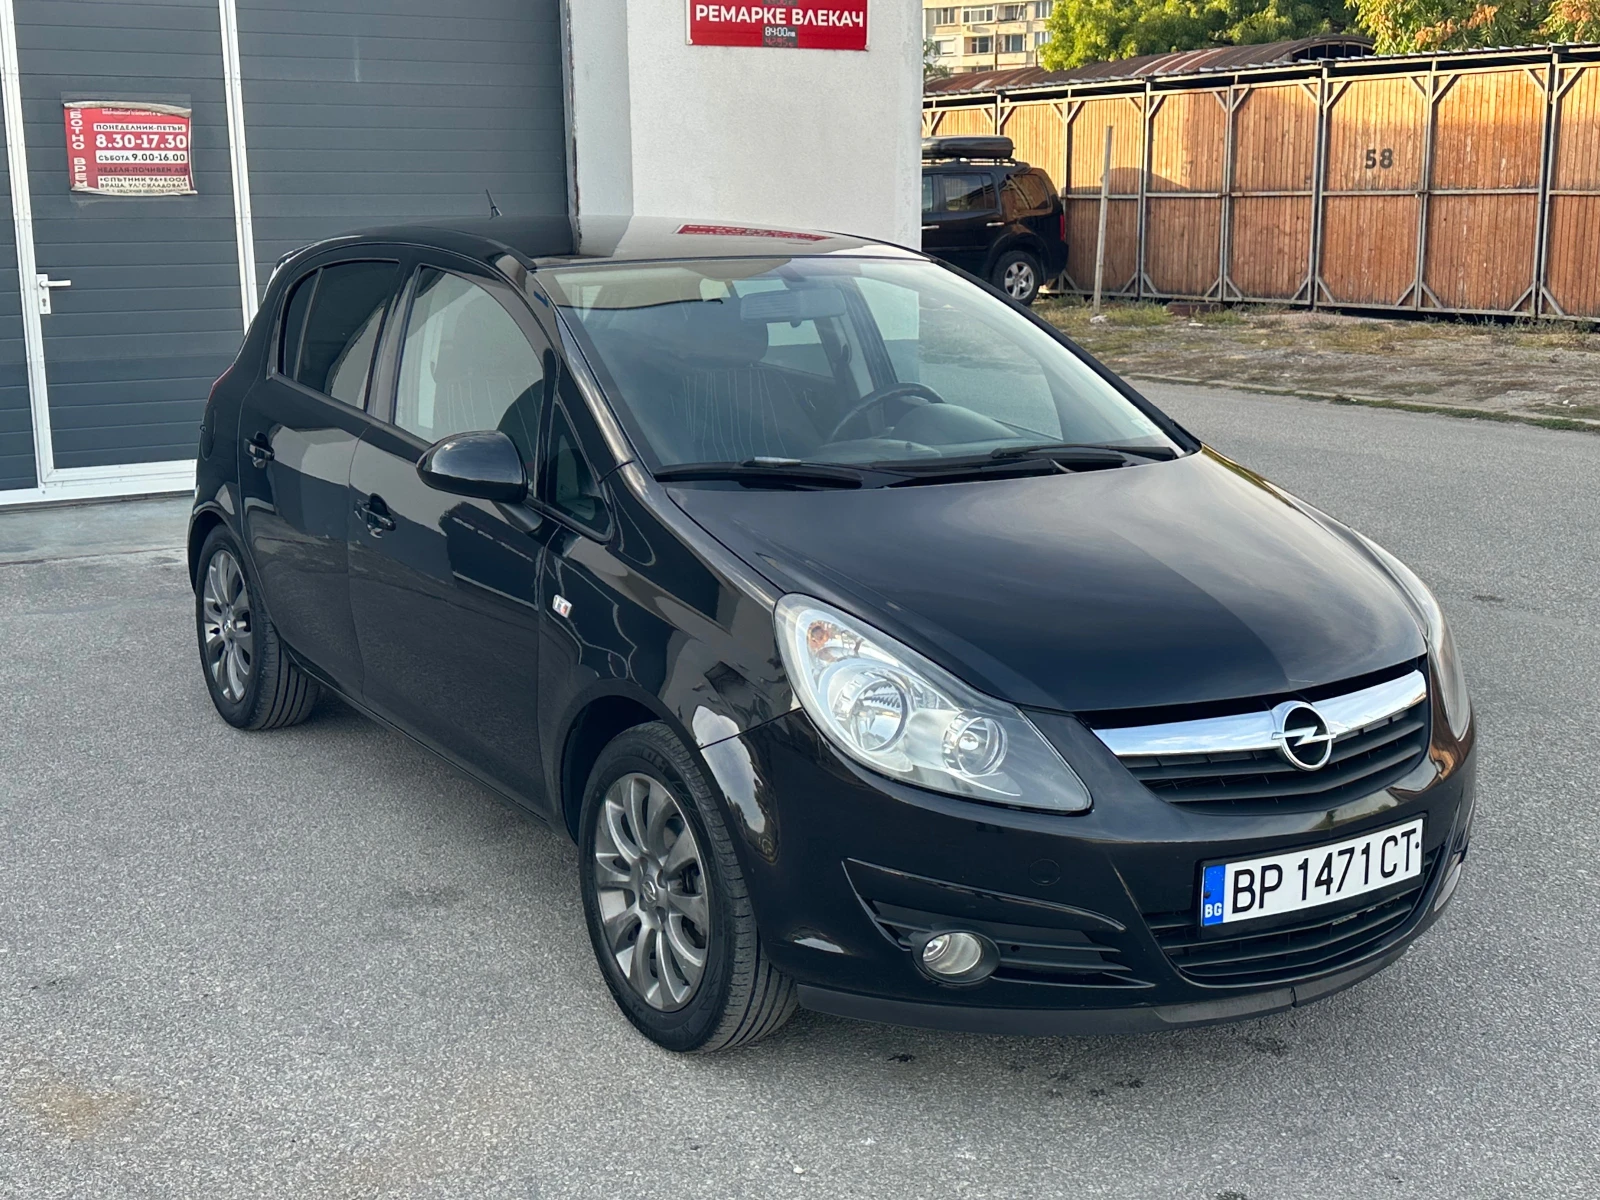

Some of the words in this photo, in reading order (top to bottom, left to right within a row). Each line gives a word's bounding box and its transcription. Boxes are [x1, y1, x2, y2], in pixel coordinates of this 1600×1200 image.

[695, 4, 787, 25] РЕМАРКЕ
[791, 8, 864, 28] ВЛЕКАЧ
[95, 134, 187, 149] 8.30-17.30
[131, 152, 186, 162] 9.00-16.00
[1364, 148, 1393, 169] 58
[1204, 902, 1223, 919] BG
[1231, 863, 1284, 914] BP
[1297, 841, 1372, 902] 1471
